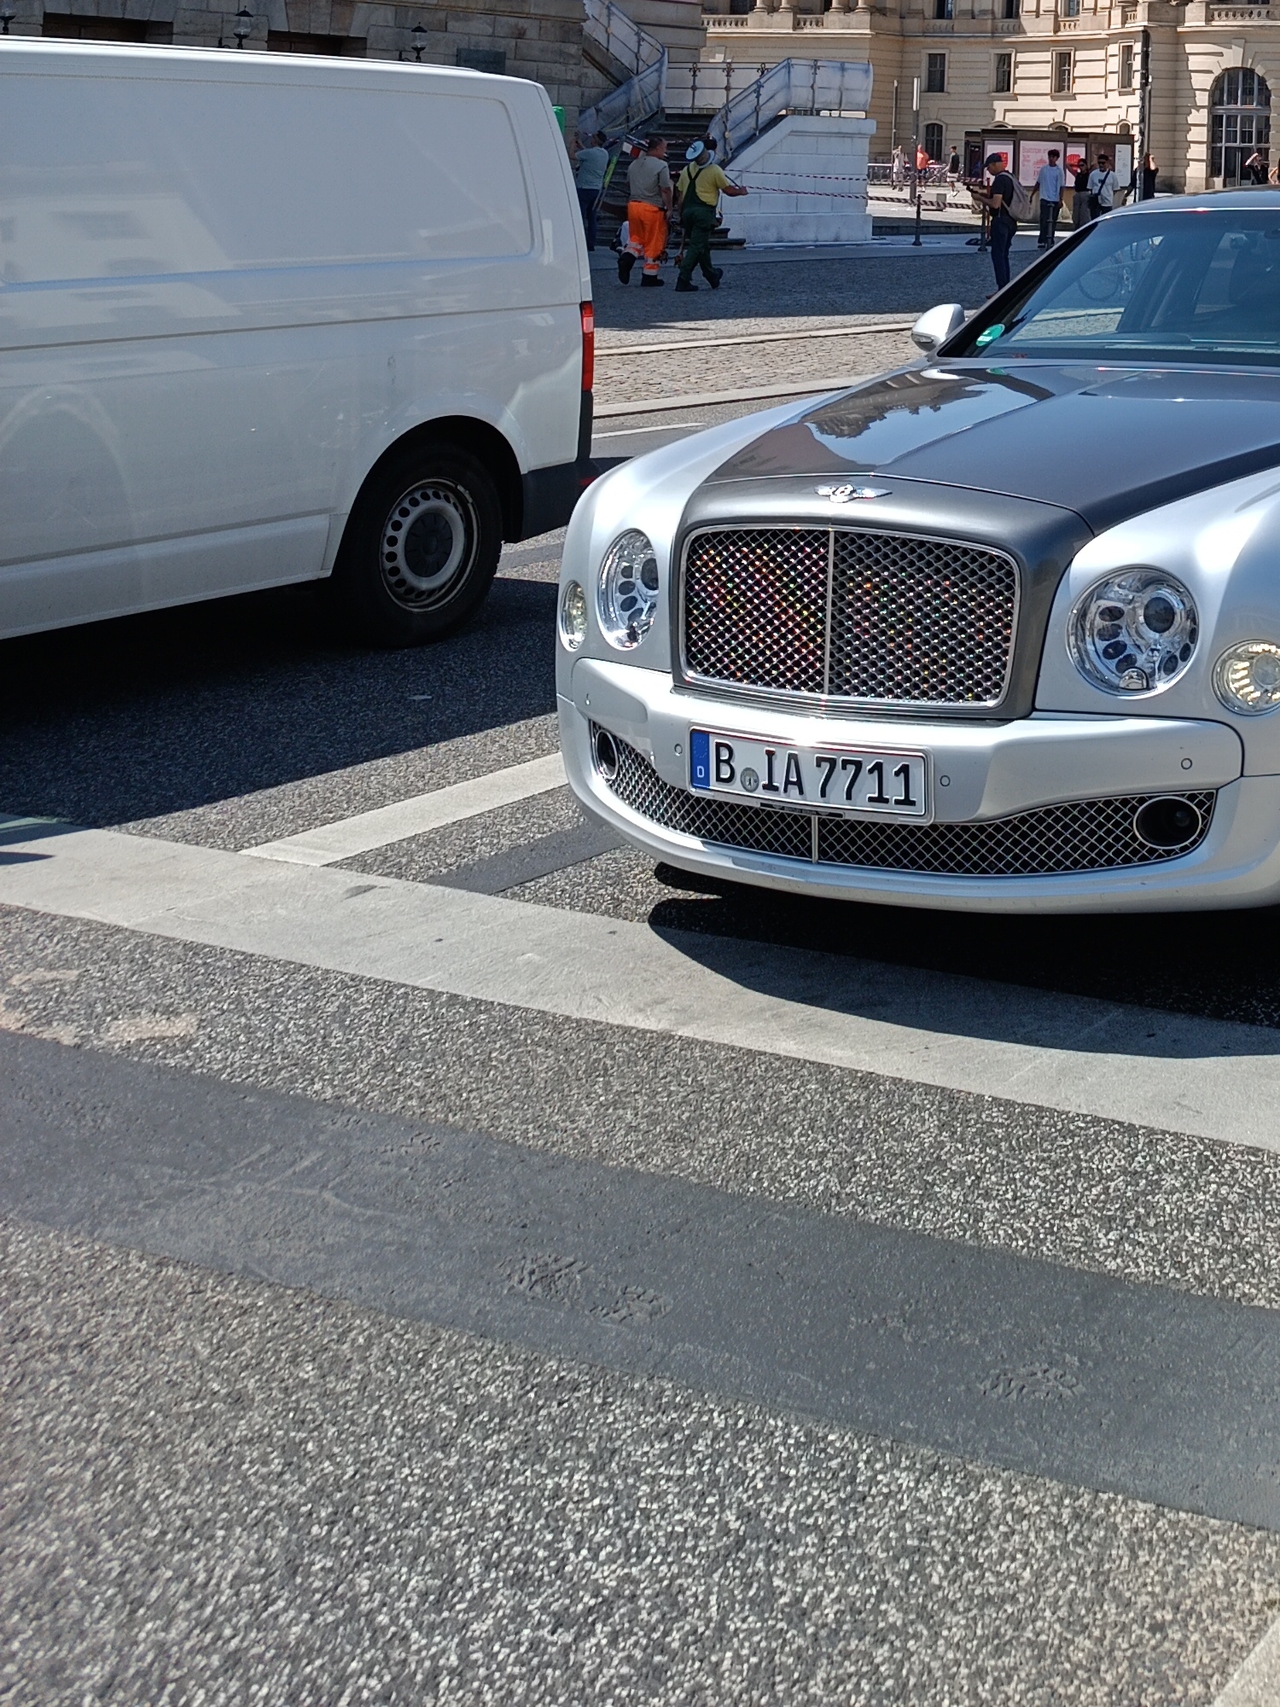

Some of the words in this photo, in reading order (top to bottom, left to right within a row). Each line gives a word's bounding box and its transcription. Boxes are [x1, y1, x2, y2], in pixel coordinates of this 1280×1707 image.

[696, 765, 705, 778] D
[714, 740, 735, 784] B
[761, 748, 805, 796] IA
[815, 755, 917, 807] 7711
